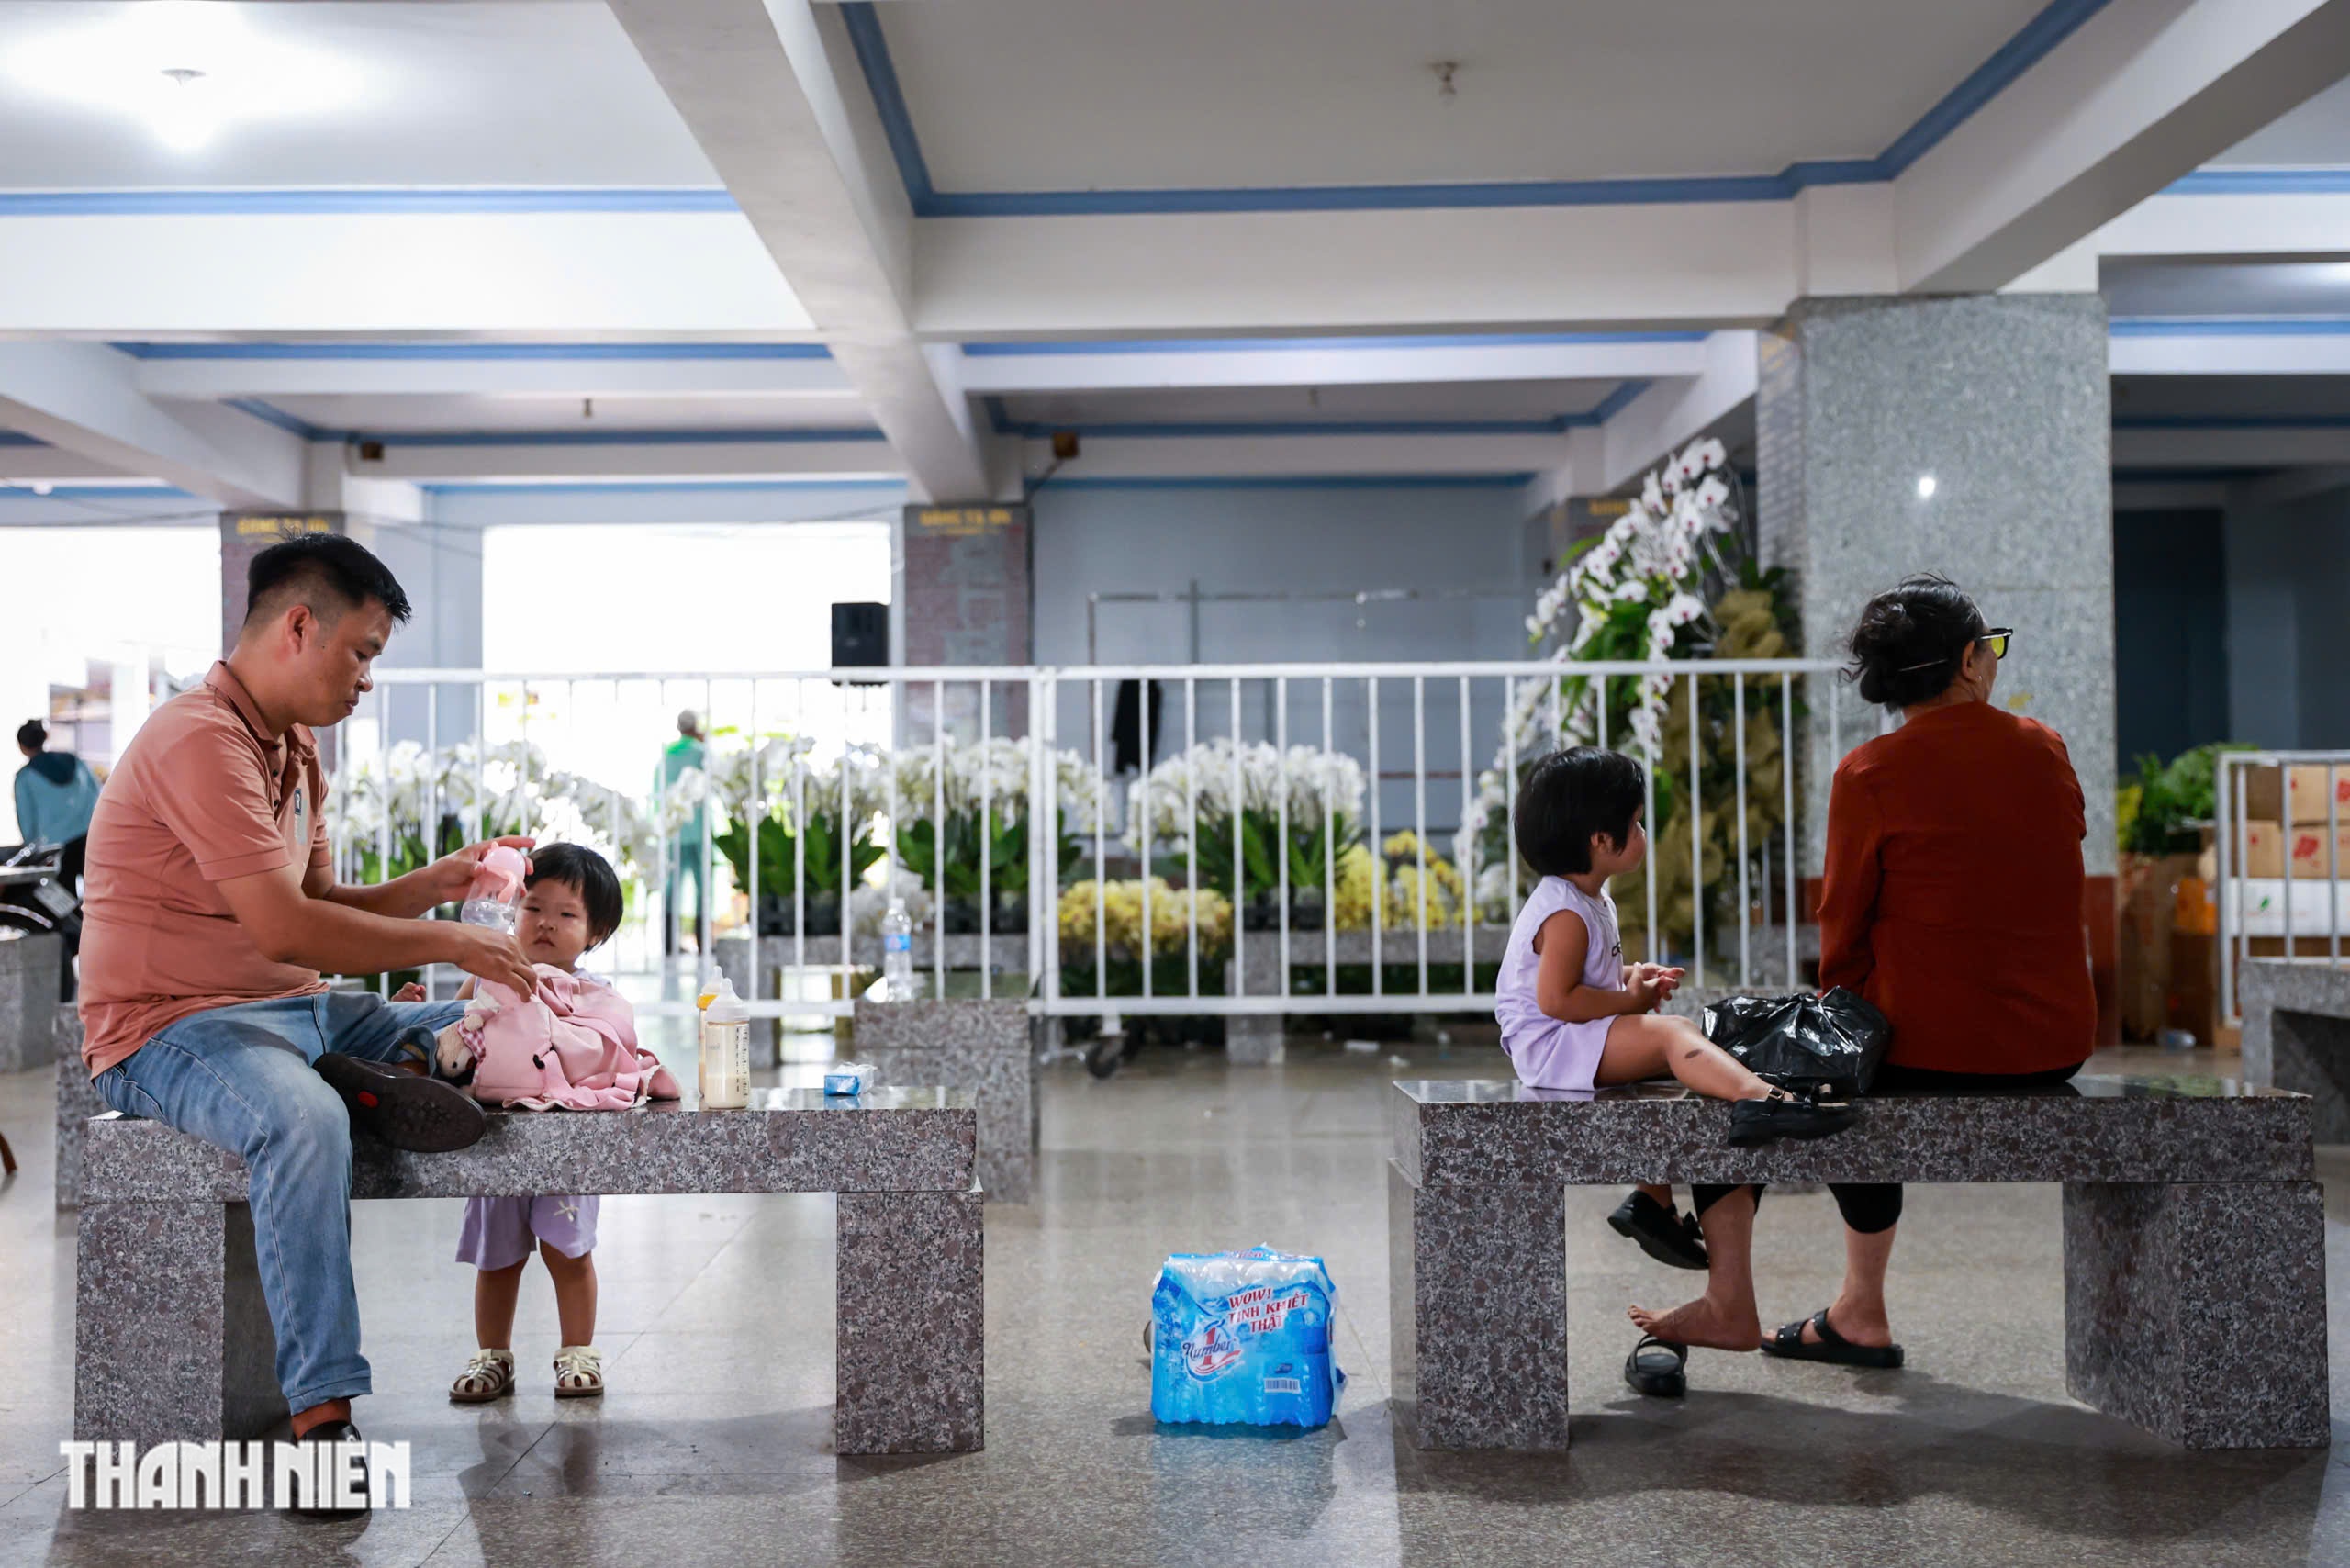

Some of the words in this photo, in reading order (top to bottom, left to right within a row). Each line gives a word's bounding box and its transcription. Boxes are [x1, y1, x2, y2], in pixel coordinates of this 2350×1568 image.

[1229, 1288, 1271, 1308] WOW!
[1266, 1291, 1309, 1314] KHIẾT
[1250, 1314, 1282, 1332] THẬT
